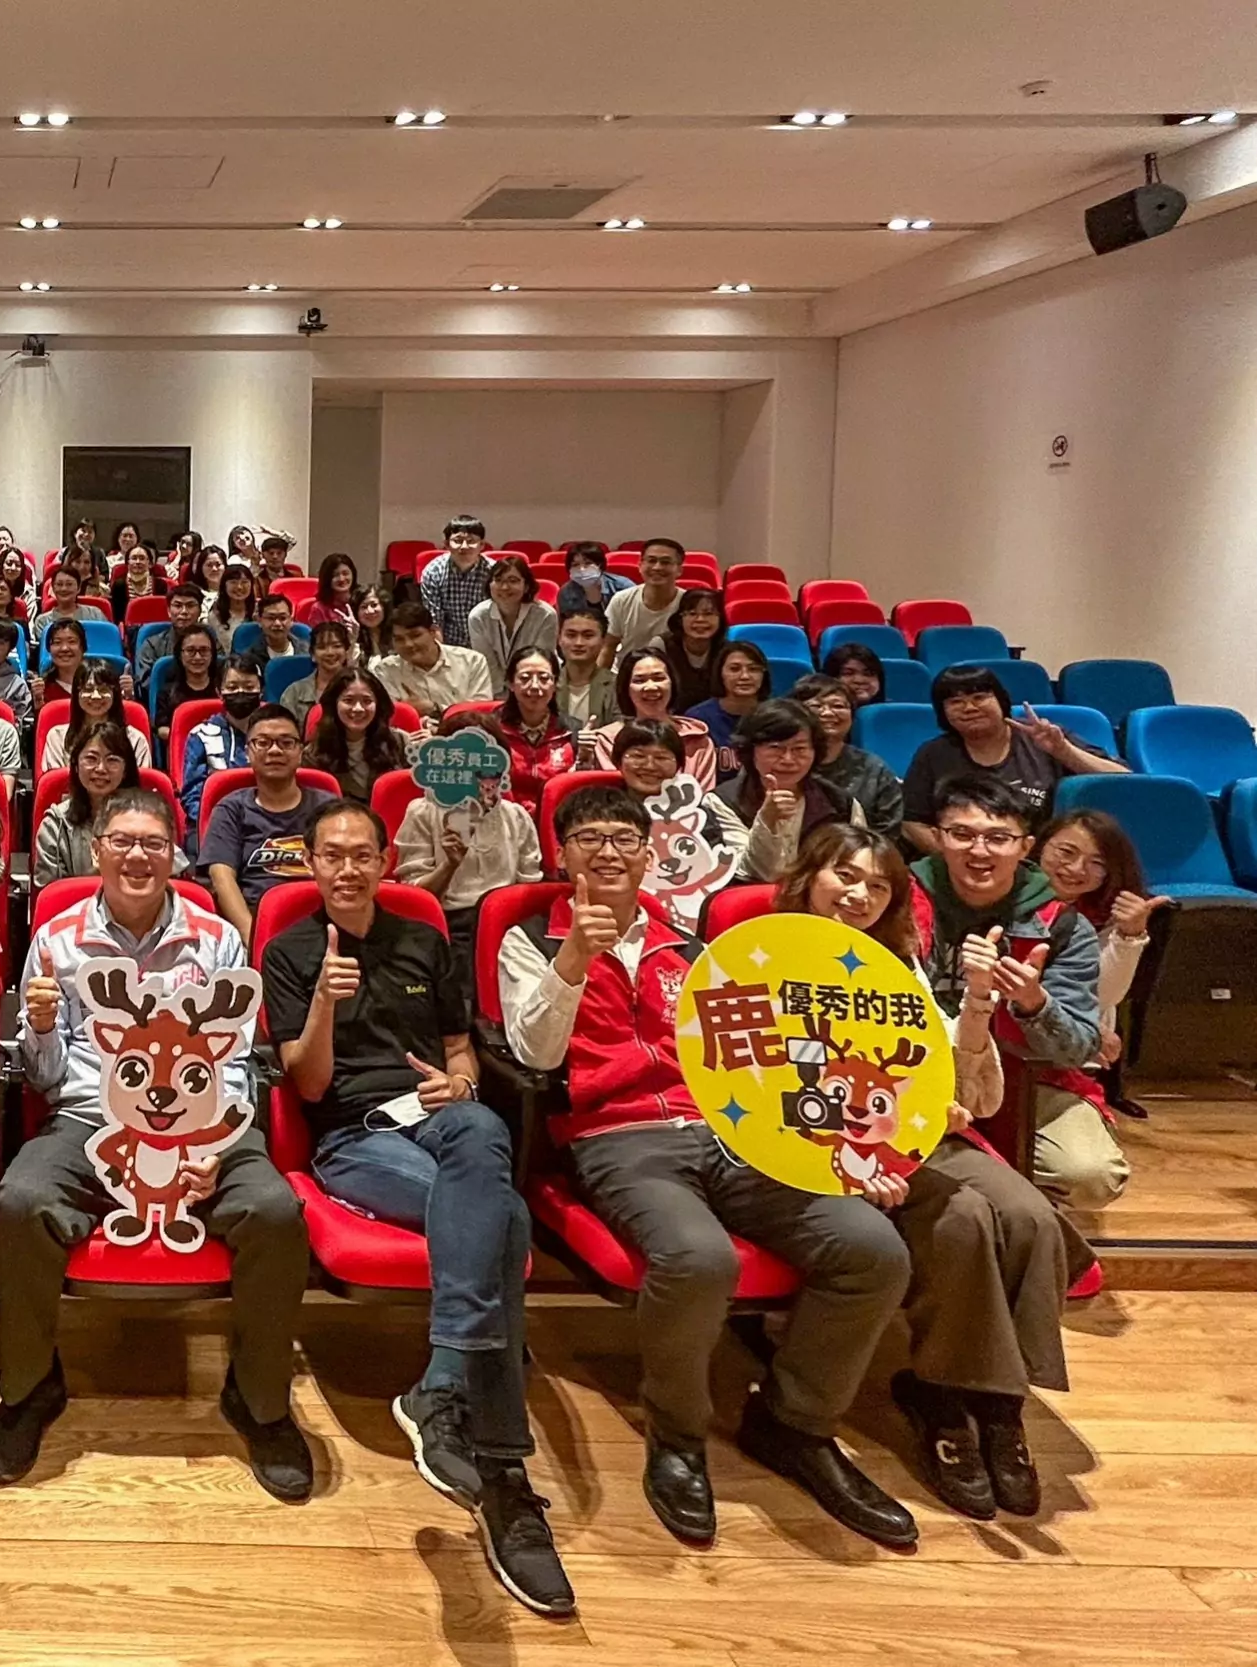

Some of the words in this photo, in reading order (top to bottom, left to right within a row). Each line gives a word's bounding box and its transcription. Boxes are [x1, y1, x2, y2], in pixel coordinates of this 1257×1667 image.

[426, 747, 498, 768] 優秀員工
[425, 769, 473, 785] 在這裡
[778, 979, 927, 1030] 優秀的我
[693, 979, 789, 1072] 鹿
